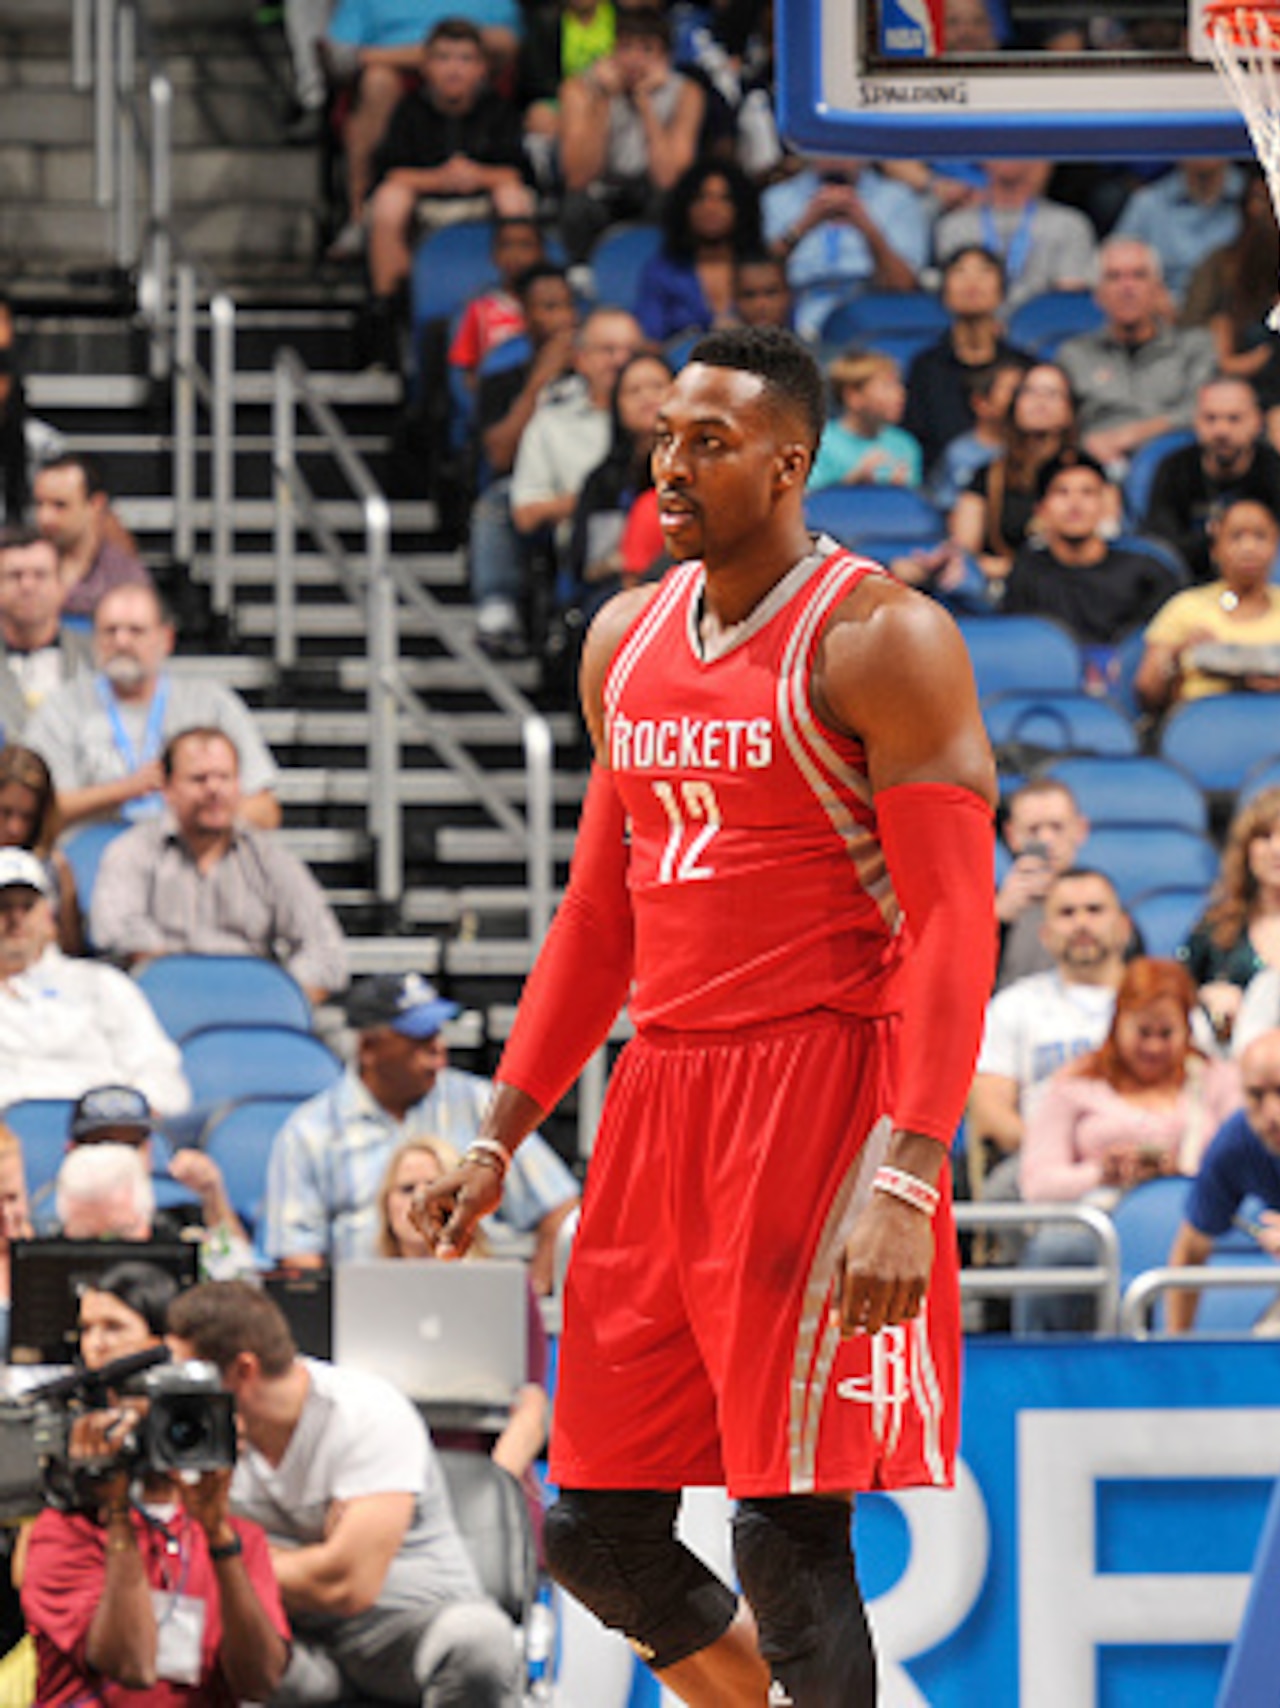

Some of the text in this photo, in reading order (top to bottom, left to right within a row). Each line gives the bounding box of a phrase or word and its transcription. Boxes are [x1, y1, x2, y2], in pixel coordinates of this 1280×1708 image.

[859, 81, 969, 107] SPALDING
[612, 712, 773, 772] ROCKETS
[651, 780, 723, 885] 12
